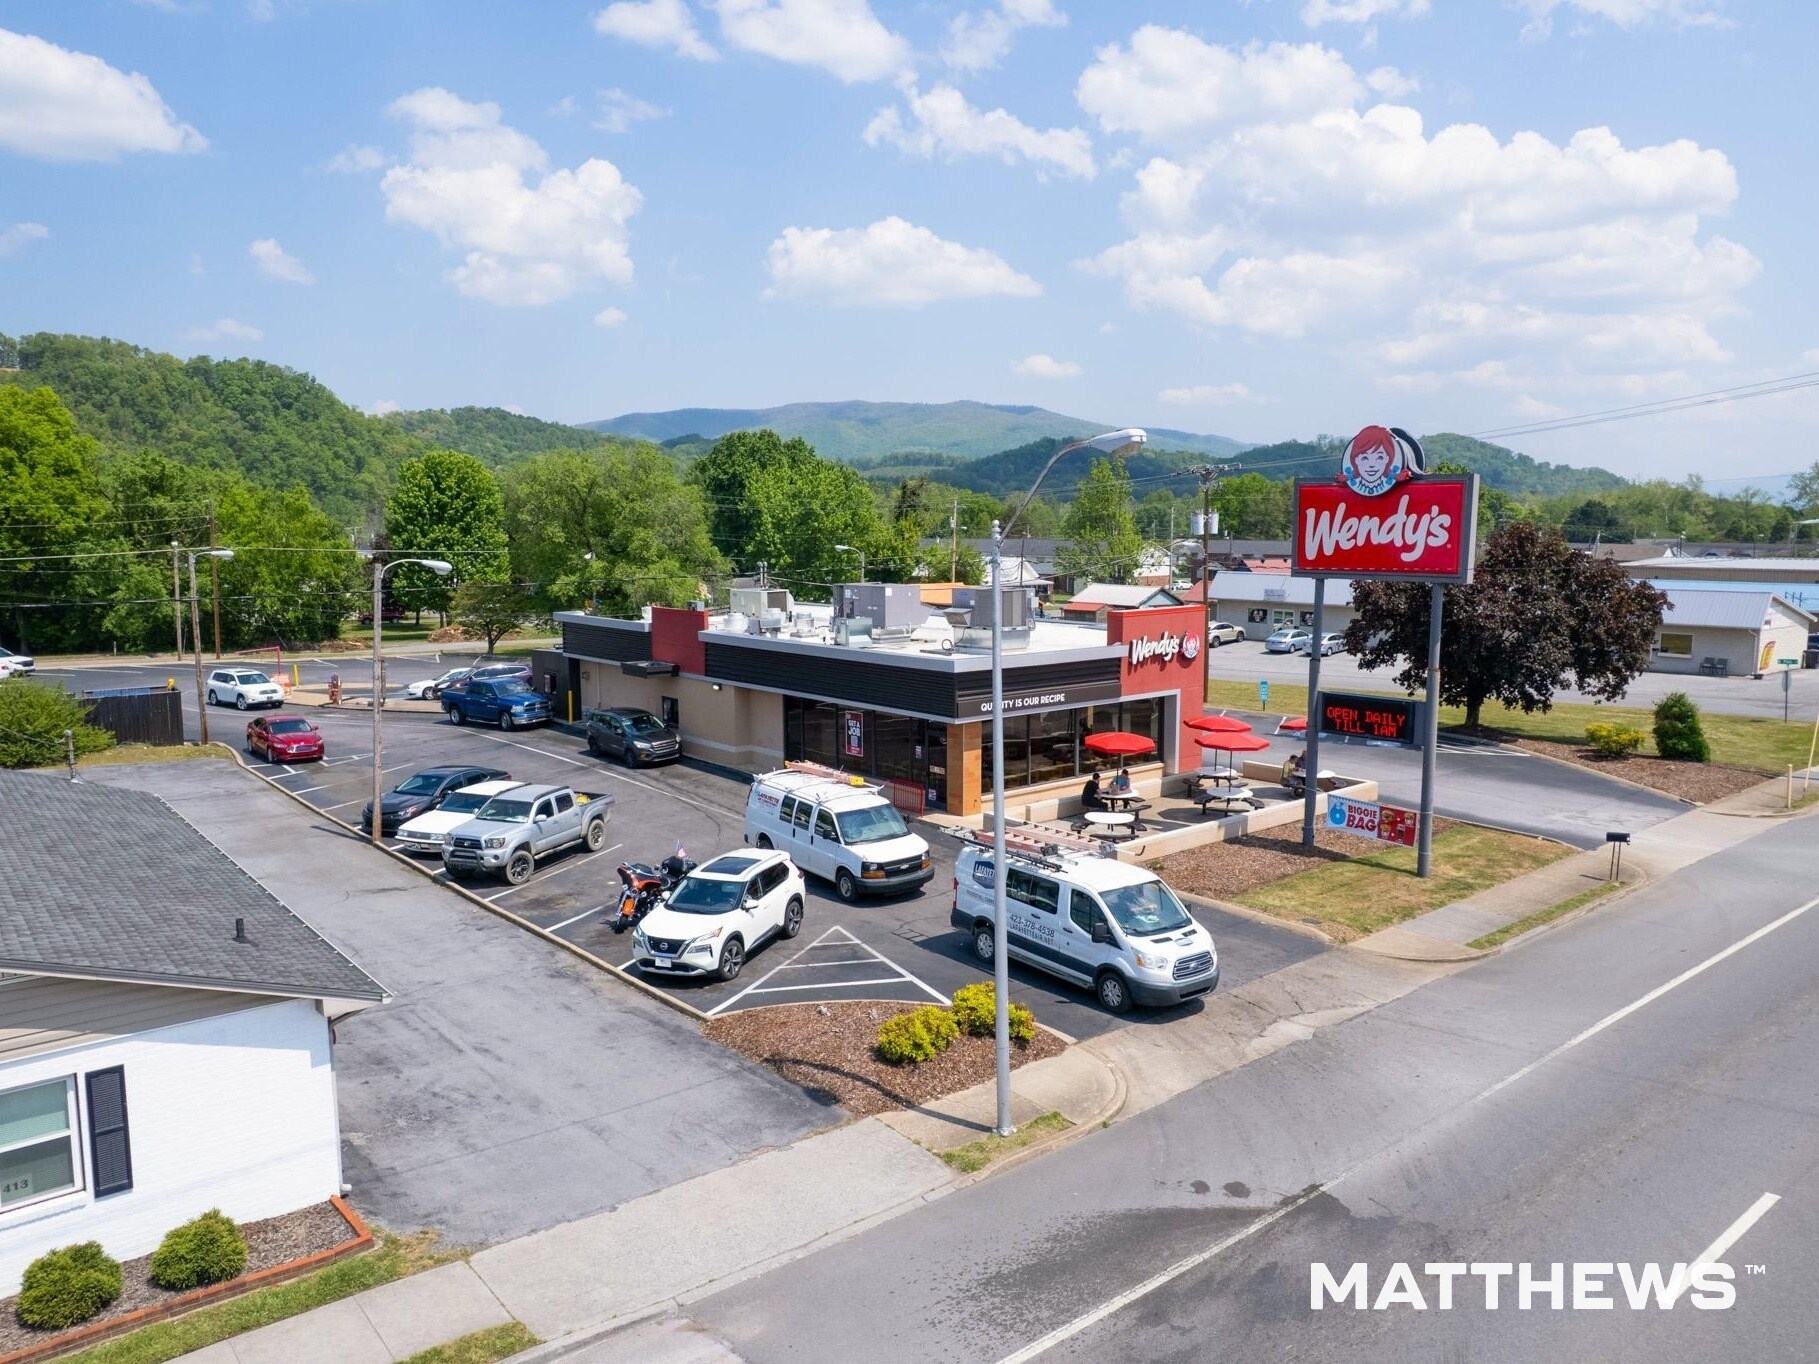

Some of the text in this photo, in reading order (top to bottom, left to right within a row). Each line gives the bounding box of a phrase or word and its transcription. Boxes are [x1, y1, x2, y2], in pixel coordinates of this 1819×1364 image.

[1305, 494, 1452, 562] Wendy's
[1130, 631, 1180, 664] Wendy's
[981, 693, 1065, 712] QUITY IS OUR RECIPE
[1326, 706, 1405, 726] OPEN DAILY
[1334, 719, 1396, 737] TILL 1AM
[1347, 805, 1377, 819] BIGGIE
[1346, 814, 1377, 832] BAG
[3, 1179, 28, 1192] 413
